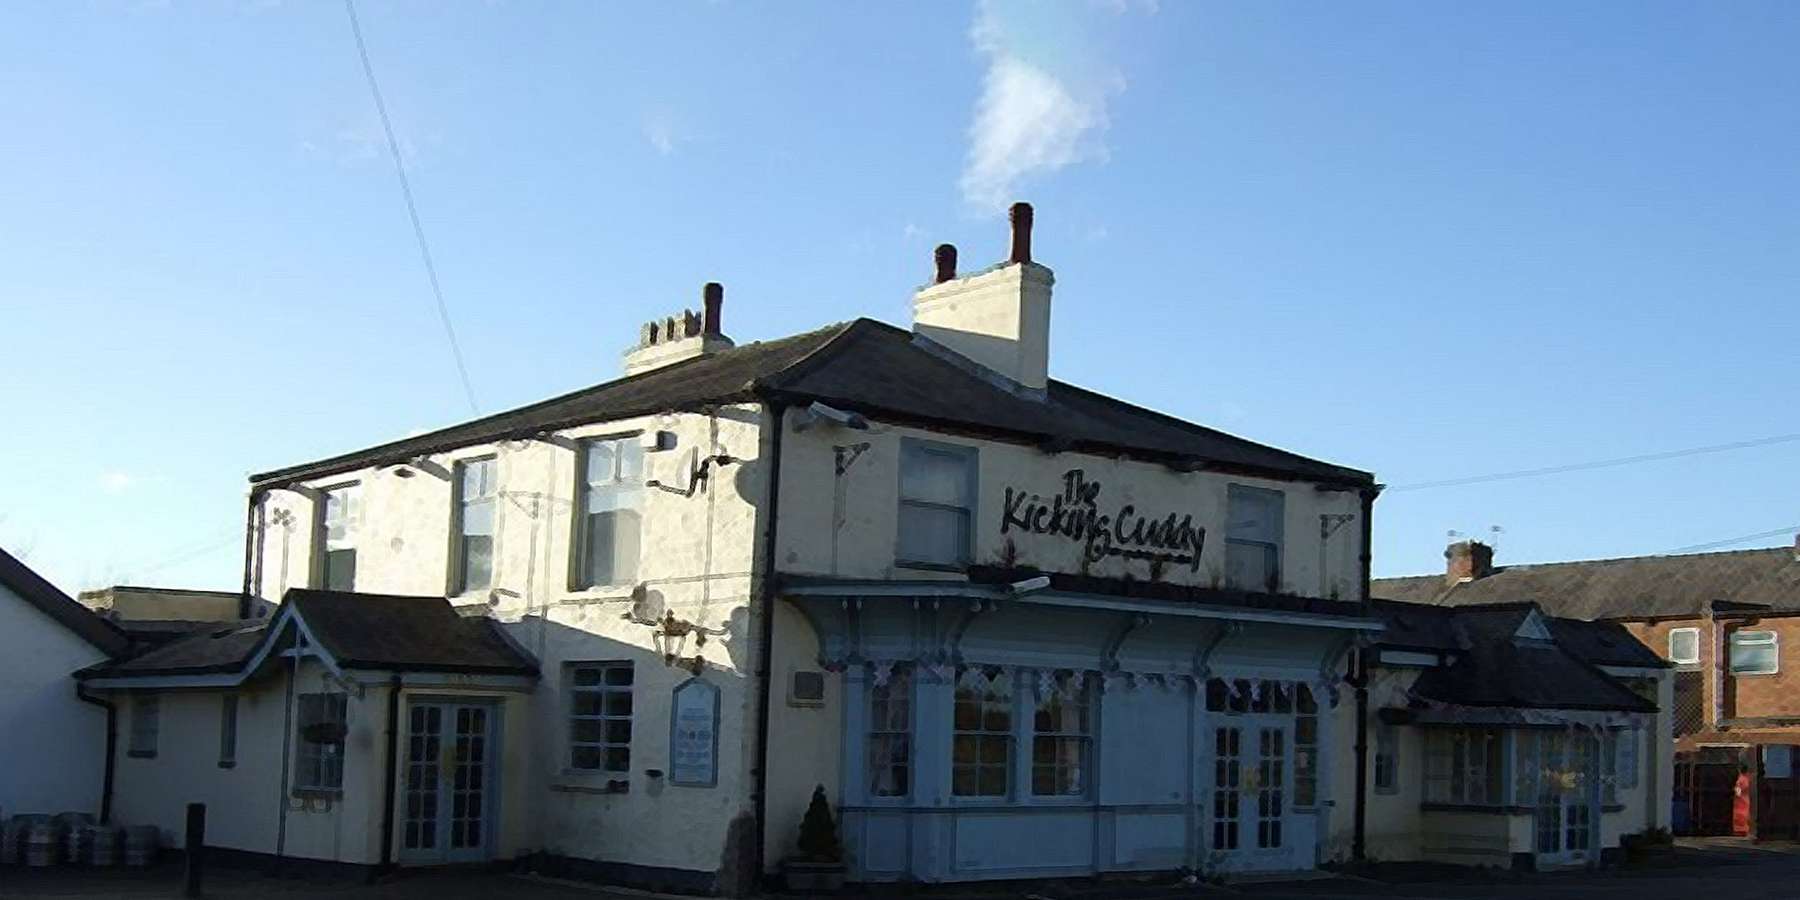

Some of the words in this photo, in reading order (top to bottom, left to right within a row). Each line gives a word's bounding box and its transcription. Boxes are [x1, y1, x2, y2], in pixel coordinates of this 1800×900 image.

[1062, 468, 1100, 505] The
[1001, 486, 1111, 563] Kicking
[1115, 504, 1206, 573] Cuddy
